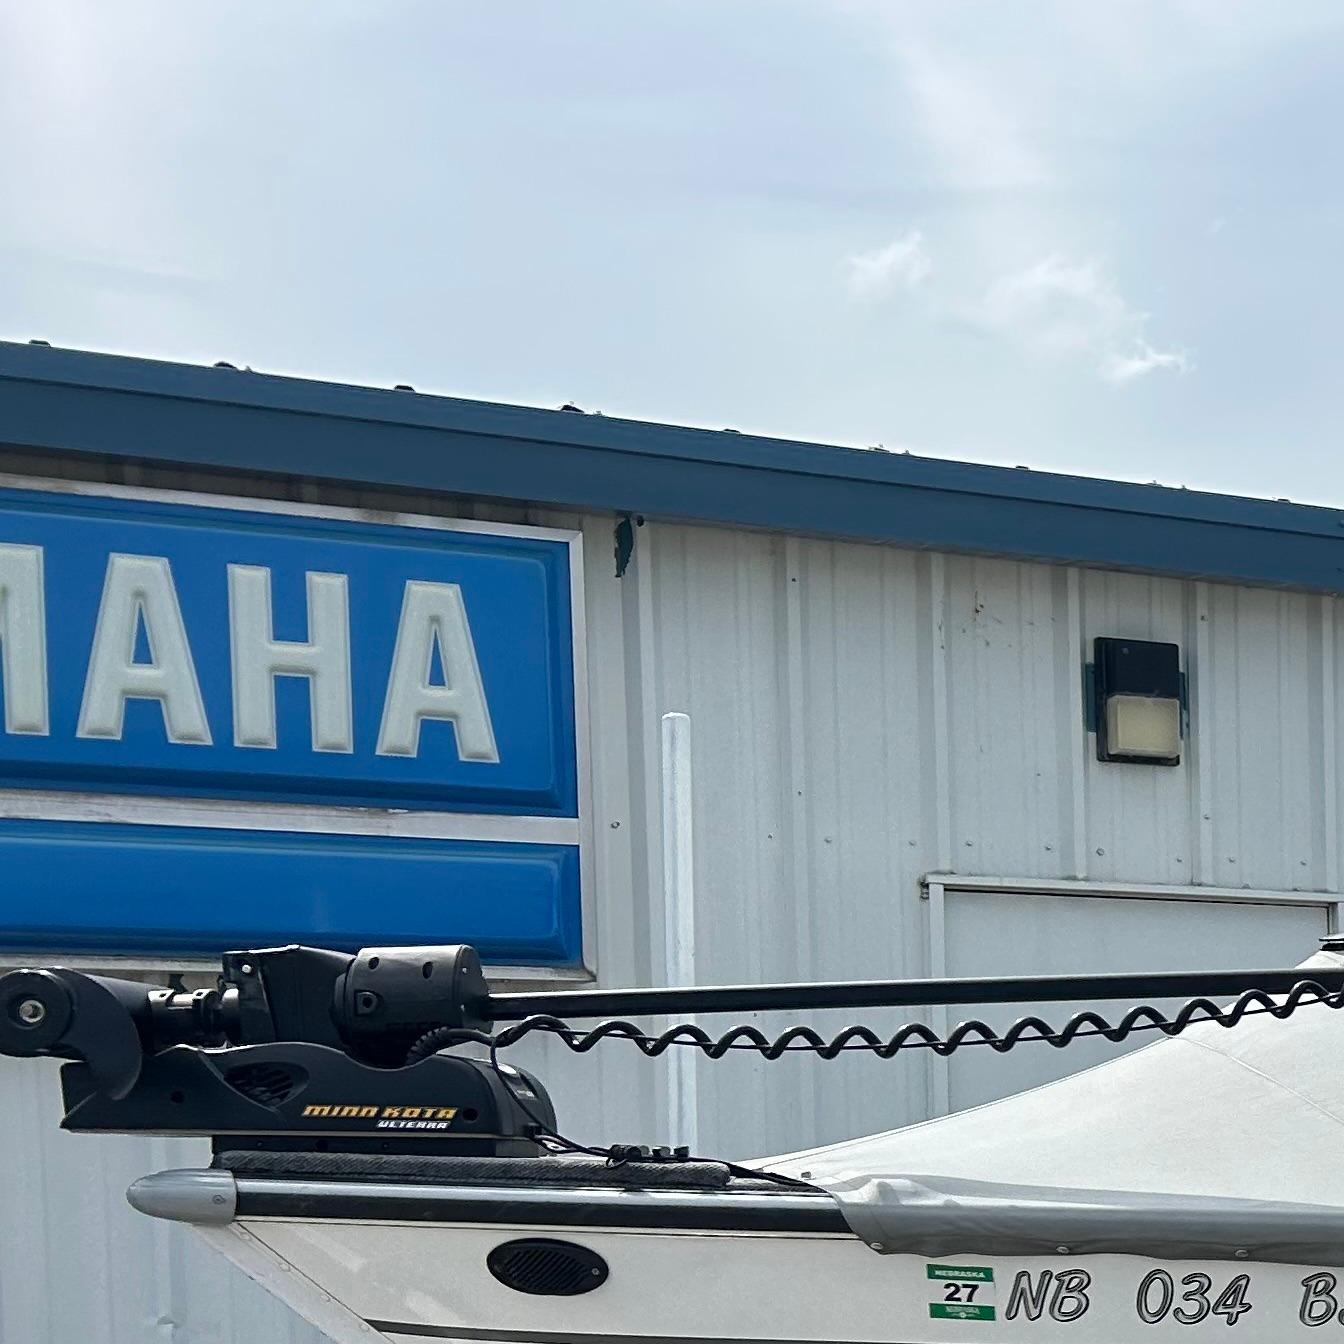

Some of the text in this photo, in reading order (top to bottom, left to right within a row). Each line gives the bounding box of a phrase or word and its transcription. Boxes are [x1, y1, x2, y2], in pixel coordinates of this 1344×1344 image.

[303, 1105, 458, 1119] MINN KOTA
[376, 1120, 450, 1129] ULTERRA
[934, 1269, 987, 1278] NEBRASKA
[943, 1283, 979, 1302] 27
[1005, 1269, 1093, 1323] NB
[1136, 1269, 1253, 1325] 034
